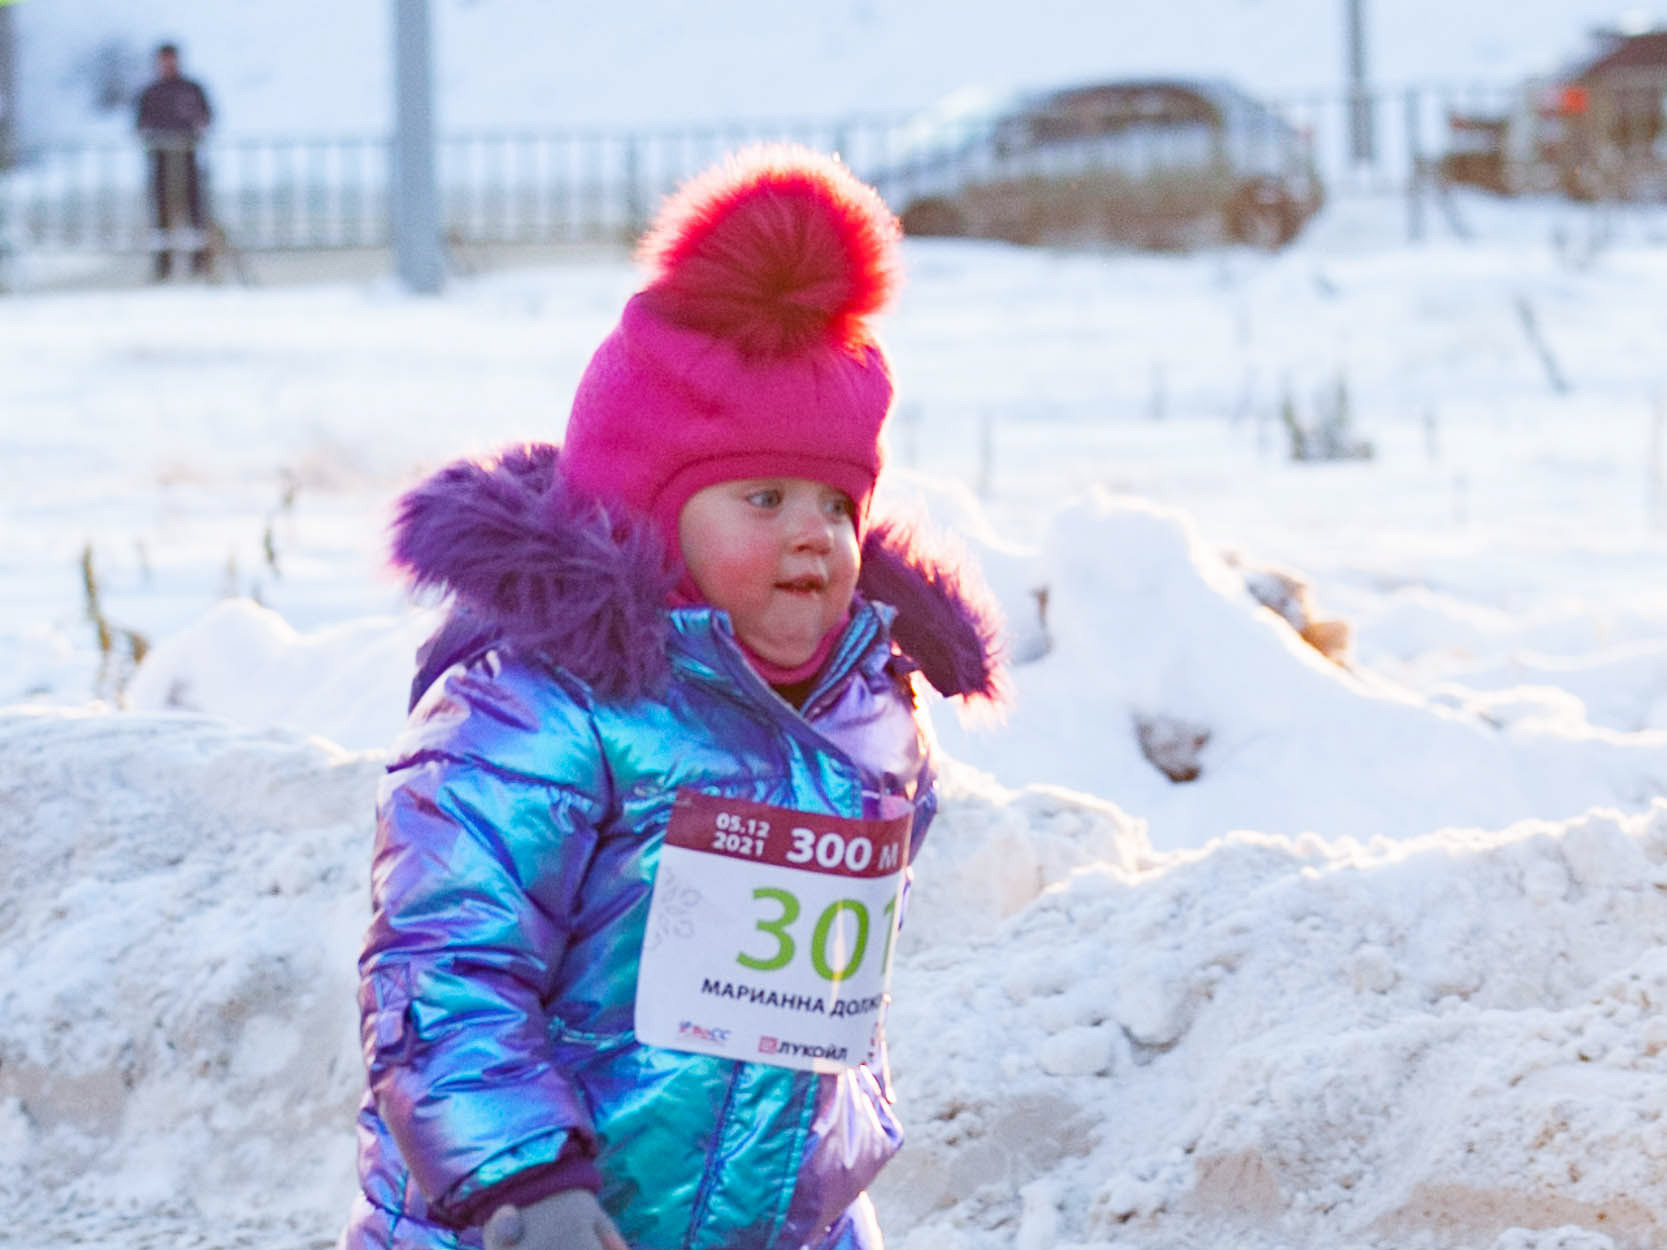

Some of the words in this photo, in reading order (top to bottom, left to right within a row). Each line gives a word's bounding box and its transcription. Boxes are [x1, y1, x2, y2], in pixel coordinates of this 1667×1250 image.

[716, 812, 770, 838] 05.12
[712, 832, 765, 856] 2021
[786, 828, 872, 871] 300
[701, 978, 826, 1015] МАРИАННА
[778, 1041, 848, 1060] ЛУКОЙЛ
